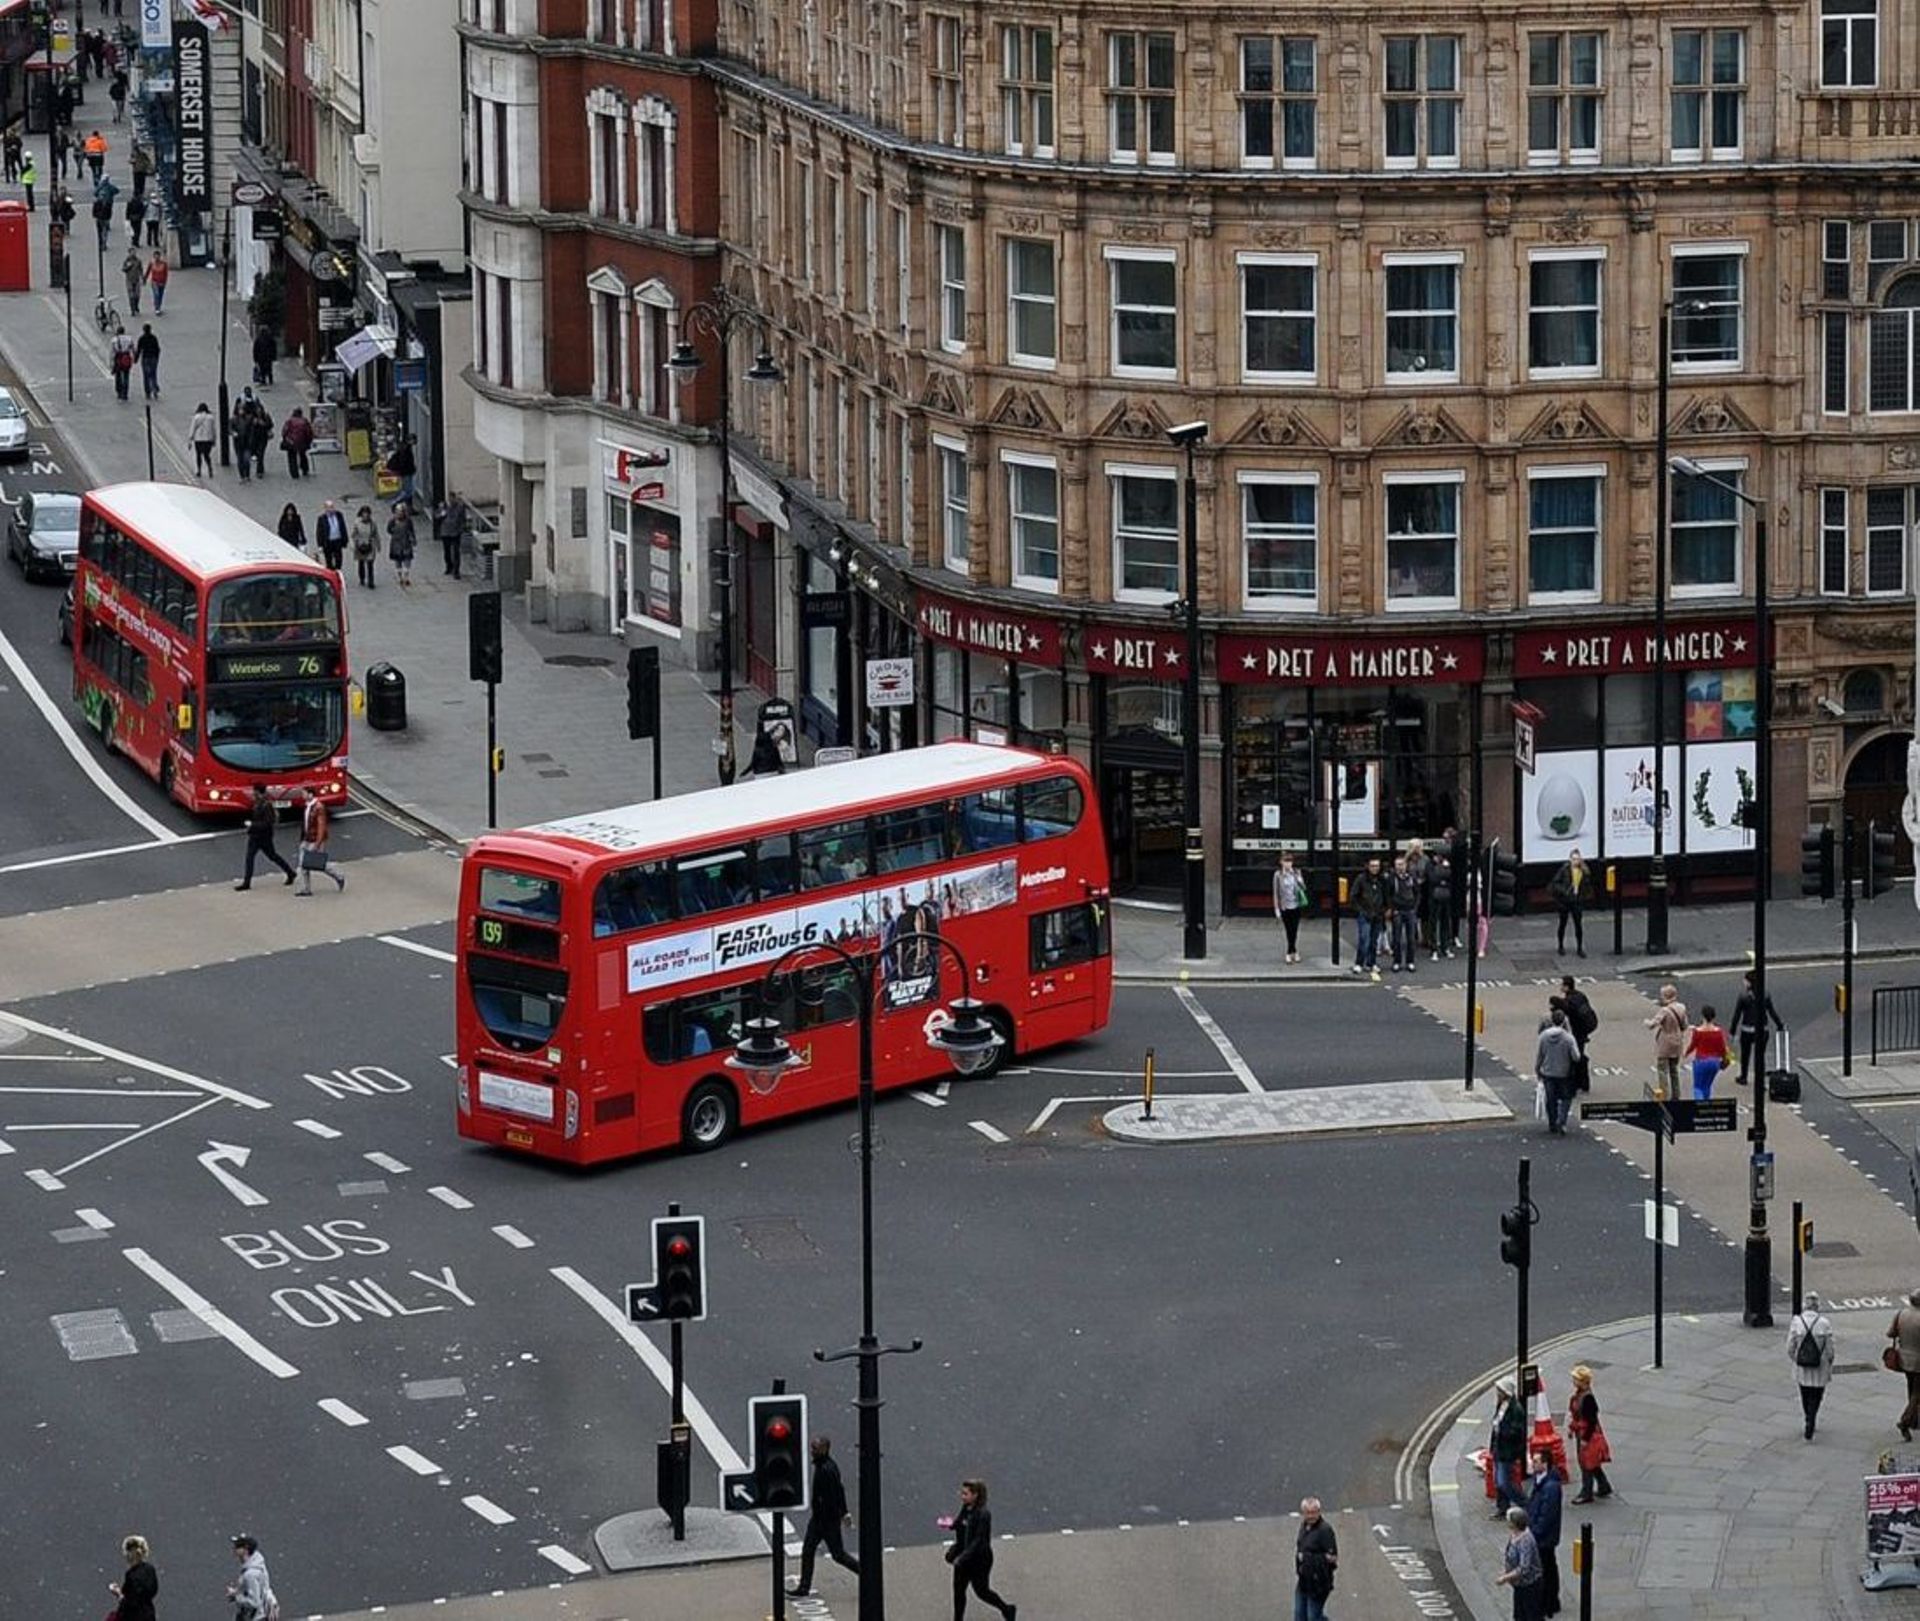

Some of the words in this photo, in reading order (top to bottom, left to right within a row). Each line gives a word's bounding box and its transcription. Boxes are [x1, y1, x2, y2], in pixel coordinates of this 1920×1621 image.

[179, 37, 203, 131] SOMERSET
[181, 137, 205, 196] HOUSE
[928, 607, 951, 638] PRET
[957, 624, 965, 642] A
[969, 618, 1024, 654] MANGER
[1114, 638, 1156, 669] PRET
[1267, 647, 1314, 677] PRET
[1325, 651, 1338, 677] A
[1350, 648, 1434, 677] MANGER
[1567, 636, 1611, 667] PRET
[1622, 641, 1634, 665] A
[1645, 630, 1724, 664] MANGER
[228, 662, 281, 675] Waterloo
[298, 657, 320, 674] 76
[483, 920, 503, 944] 139
[716, 923, 766, 952] FAST
[719, 930, 801, 966] FURIOUS
[803, 922, 818, 942] 6
[632, 957, 650, 968] ALL
[654, 947, 690, 963] ROADS
[641, 963, 669, 976] LEAD
[672, 959, 685, 969] TO
[688, 952, 711, 965] THIS
[302, 1065, 414, 1099] NO
[221, 1219, 390, 1270] BUS
[270, 1266, 475, 1329] ONLY
[1827, 1296, 1893, 1310] LOOK
[1869, 1482, 1901, 1497] 25%
[1903, 1484, 1917, 1495] off
